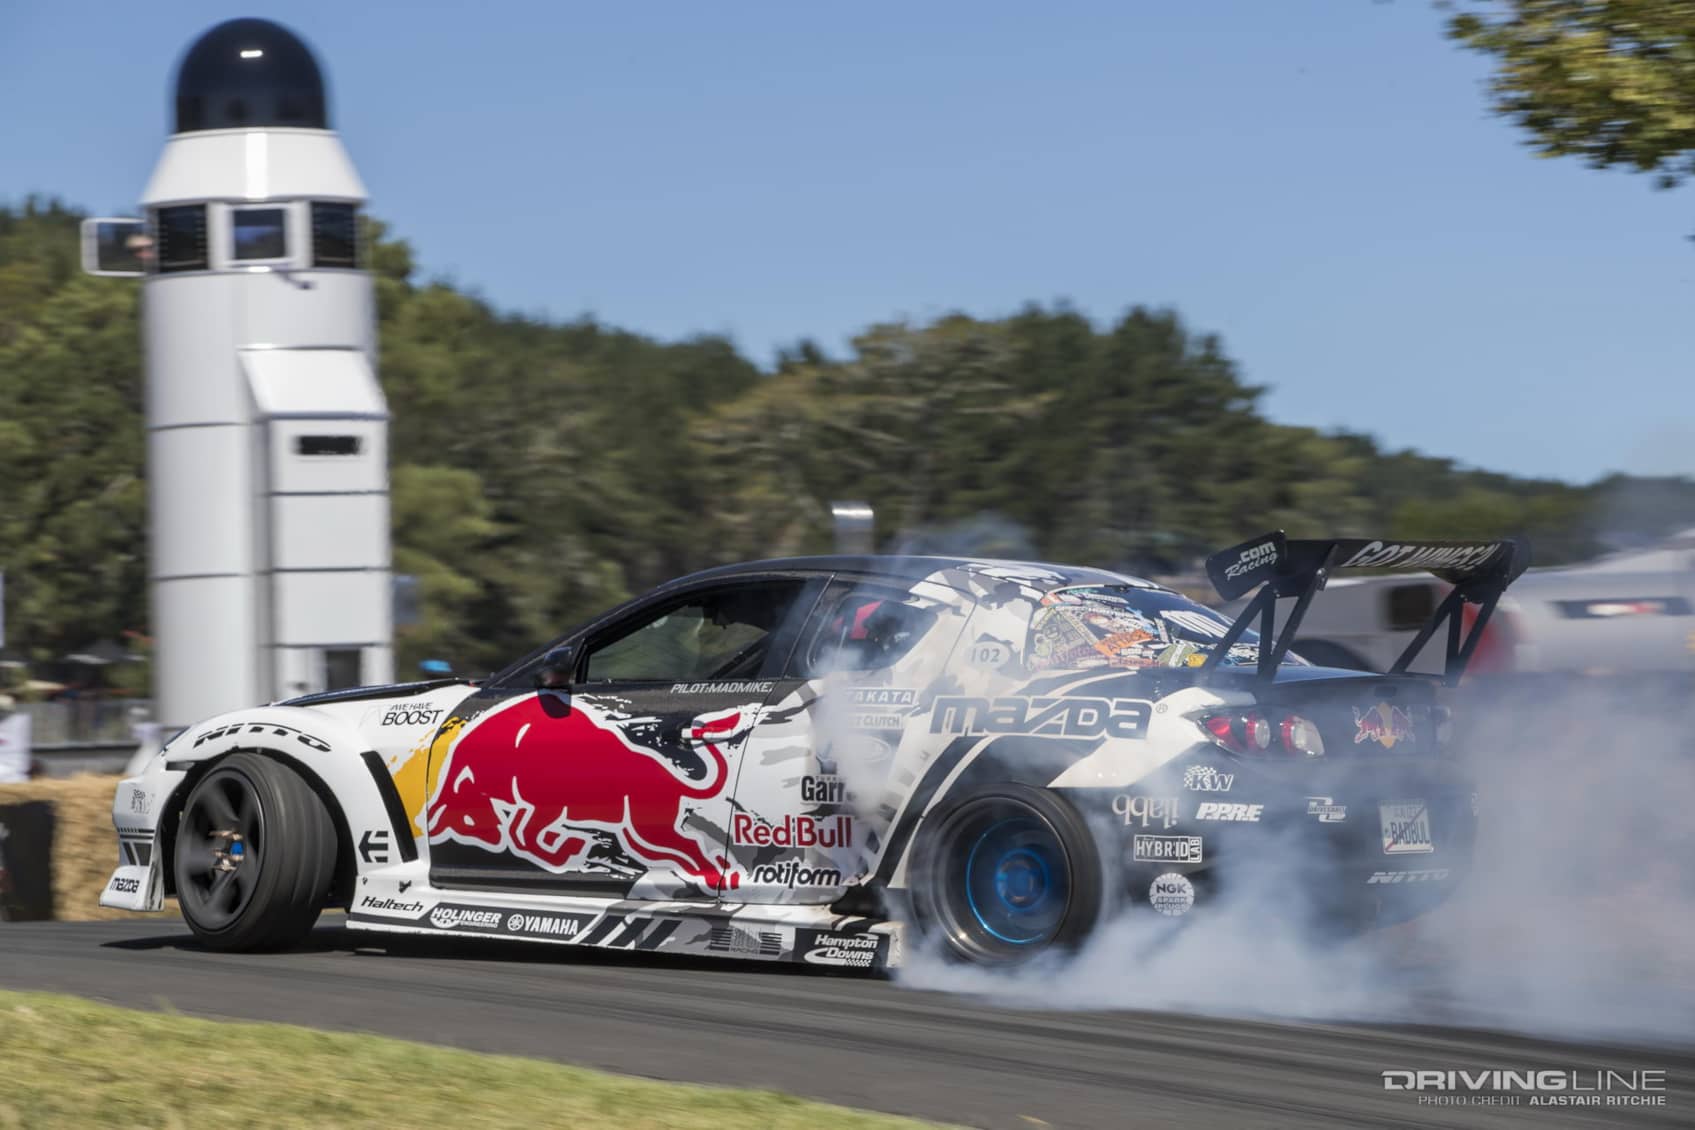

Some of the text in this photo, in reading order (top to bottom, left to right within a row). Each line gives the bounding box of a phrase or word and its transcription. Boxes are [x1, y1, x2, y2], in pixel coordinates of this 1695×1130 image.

[1238, 541, 1276, 564] .com
[1224, 552, 1278, 580] Racing
[846, 691, 912, 704] AKATA
[382, 710, 444, 726] BOOST
[801, 775, 856, 802] Garr
[1191, 773, 1234, 791] KW
[733, 814, 853, 848] Red Bull
[1135, 839, 1200, 861] HYBRID LAB
[753, 862, 841, 889] rotiform
[1156, 883, 1187, 894] NGK
[361, 896, 423, 912] Haltech
[432, 908, 502, 923] HOLINGER
[524, 915, 580, 935] YAMAHA
[814, 934, 878, 950] Hampton
[825, 947, 875, 960] Downs
